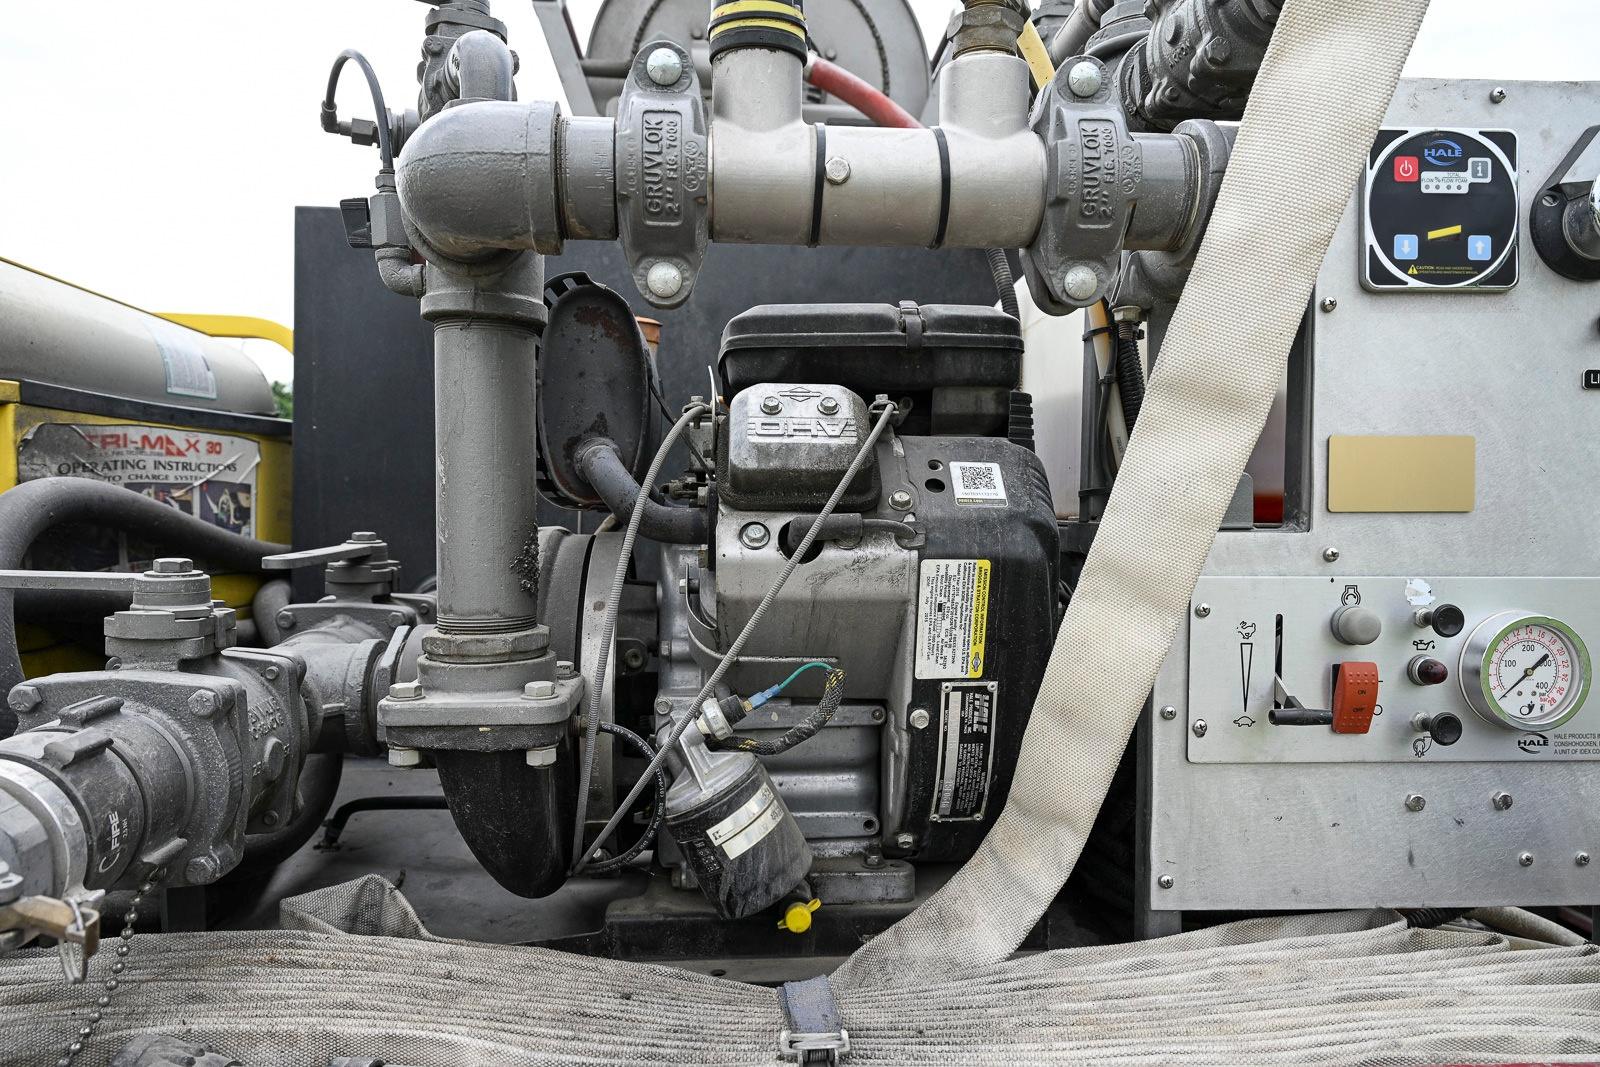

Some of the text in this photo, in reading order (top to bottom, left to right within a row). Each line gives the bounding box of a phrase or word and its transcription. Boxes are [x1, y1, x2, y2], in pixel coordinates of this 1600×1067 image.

[666, 120, 678, 149] 7000
[1102, 128, 1115, 154] 7000
[1424, 148, 1462, 158] HALE
[644, 119, 664, 215] GRUVLOK
[1082, 126, 1100, 216] GRUVLOK
[206, 440, 222, 455] 30
[58, 458, 237, 476] OPERATING INSTRUCTIONS
[128, 474, 170, 482] CHARGE
[1526, 627, 1532, 635] 14
[1538, 630, 1546, 638] 16
[1549, 636, 1557, 646] 18
[1556, 647, 1566, 656] 20
[1504, 660, 1516, 668] 100
[1562, 660, 1569, 668] 22
[1562, 673, 1568, 682] 24
[1536, 682, 1548, 690] 400
[1556, 686, 1565, 696] 26
[973, 694, 989, 734] HALE
[1518, 739, 1549, 747] HALE
[108, 811, 120, 852] FIRE
